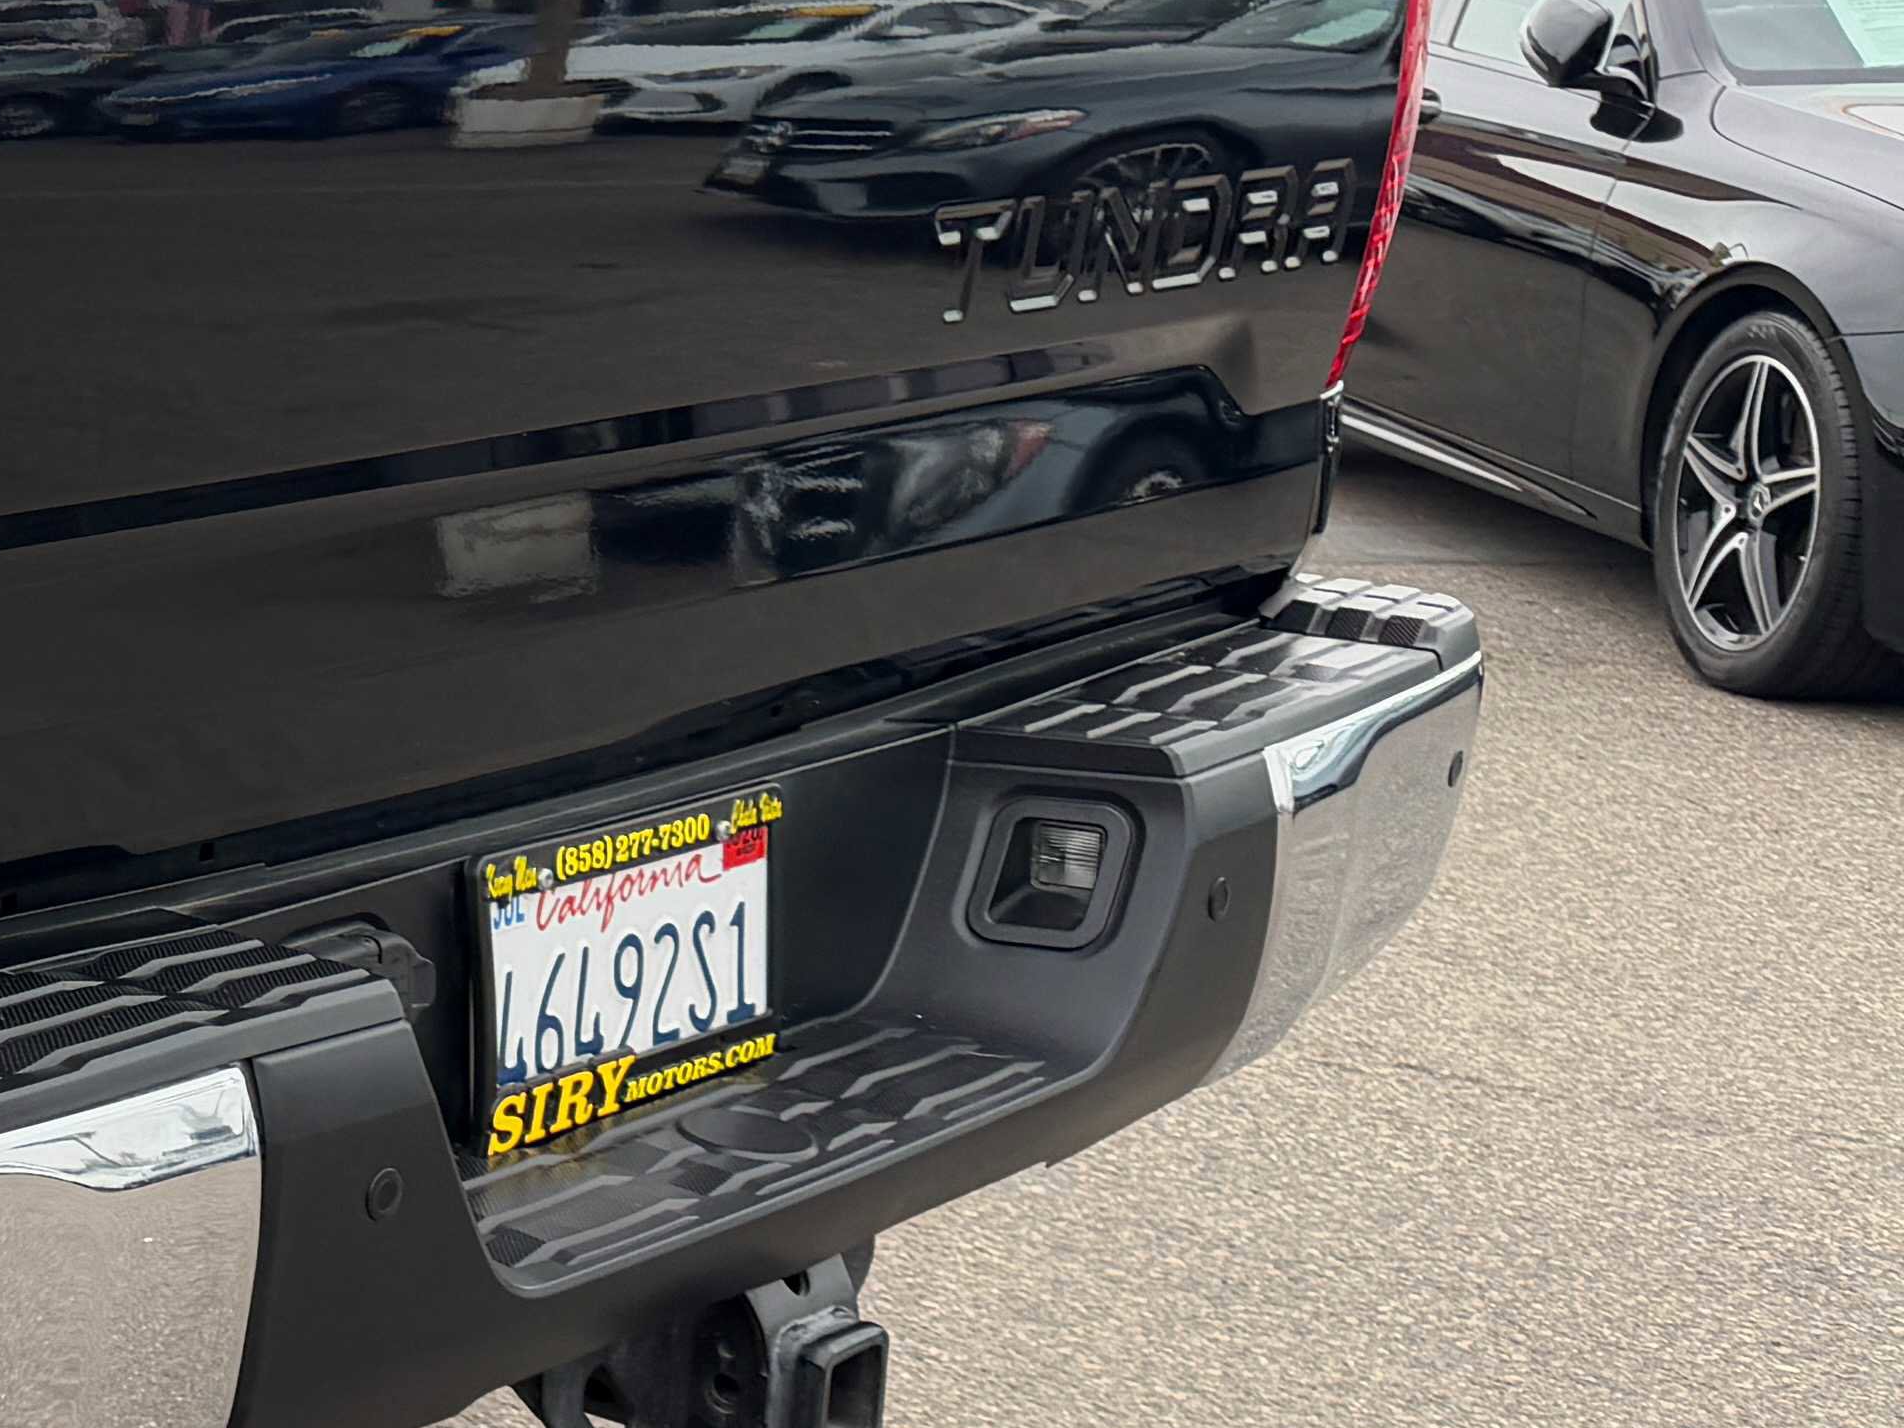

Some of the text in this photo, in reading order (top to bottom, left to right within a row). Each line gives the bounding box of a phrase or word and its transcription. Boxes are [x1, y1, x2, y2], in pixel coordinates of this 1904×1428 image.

[935, 158, 1356, 322] TUNDRA
[536, 853, 722, 934] California
[498, 901, 756, 1085] 46492S1
[488, 1034, 777, 1156] SIRY MOTORS.COM
